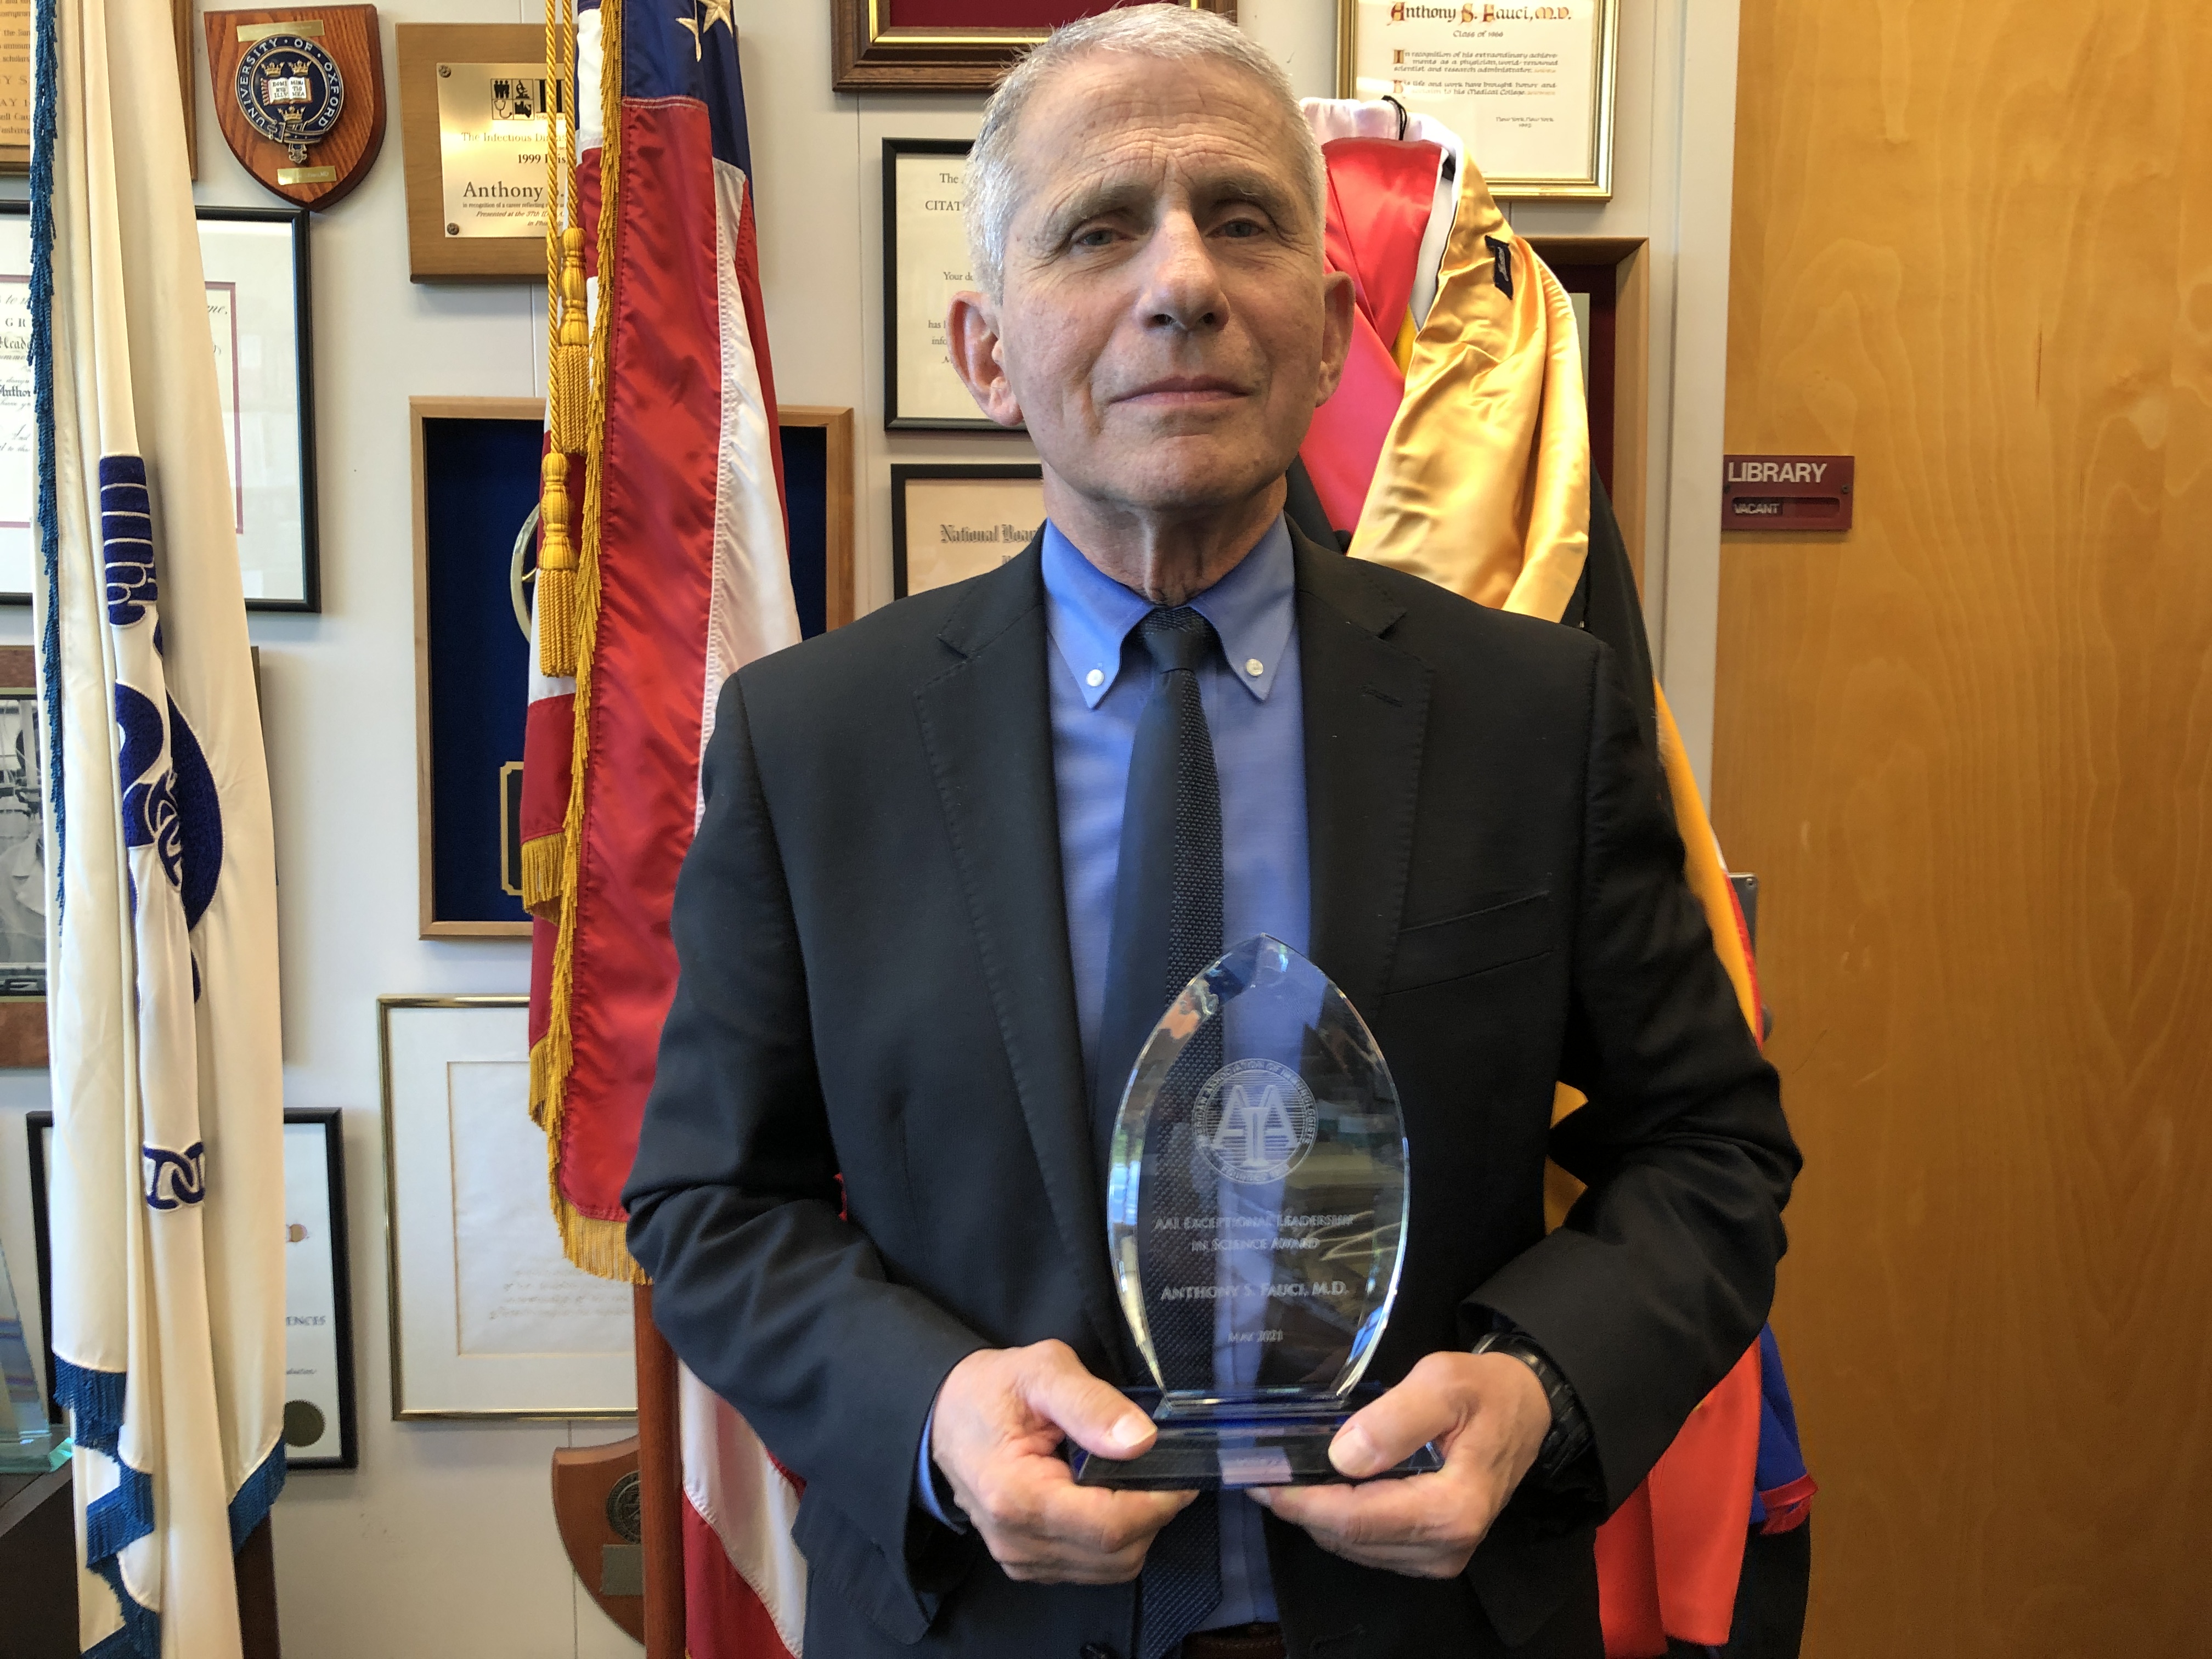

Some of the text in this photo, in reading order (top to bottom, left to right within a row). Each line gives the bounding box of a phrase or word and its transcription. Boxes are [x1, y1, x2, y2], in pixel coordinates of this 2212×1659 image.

[1387, 1, 1572, 26] Anthony S. Fauci, M.D.
[1453, 30, 1475, 38] Class
[240, 38, 340, 127] UNIVERSITY OF OXFORD
[461, 132, 480, 142] The
[484, 132, 532, 142] Infectious
[518, 154, 541, 164] 1999
[939, 172, 959, 184] The
[463, 181, 544, 202] Anthony
[924, 200, 965, 211] CITAT
[943, 272, 963, 280] Your
[928, 320, 941, 329] has
[1728, 462, 1828, 483] LIBRARY
[1733, 503, 1780, 514] VACANT
[940, 524, 1040, 544] National Boar
[1184, 1214, 1273, 1230] EXCEPTIONAL
[1277, 1214, 1355, 1227] LEADERSHIP
[1211, 1237, 1268, 1252] SCIENCE
[1271, 1237, 1321, 1250] AWARD
[1160, 1285, 1238, 1302] ANTHONY
[1312, 1280, 1350, 1296] M.D.
[286, 1316, 326, 1326] ENCES
[1256, 1329, 1284, 1343] 2021
